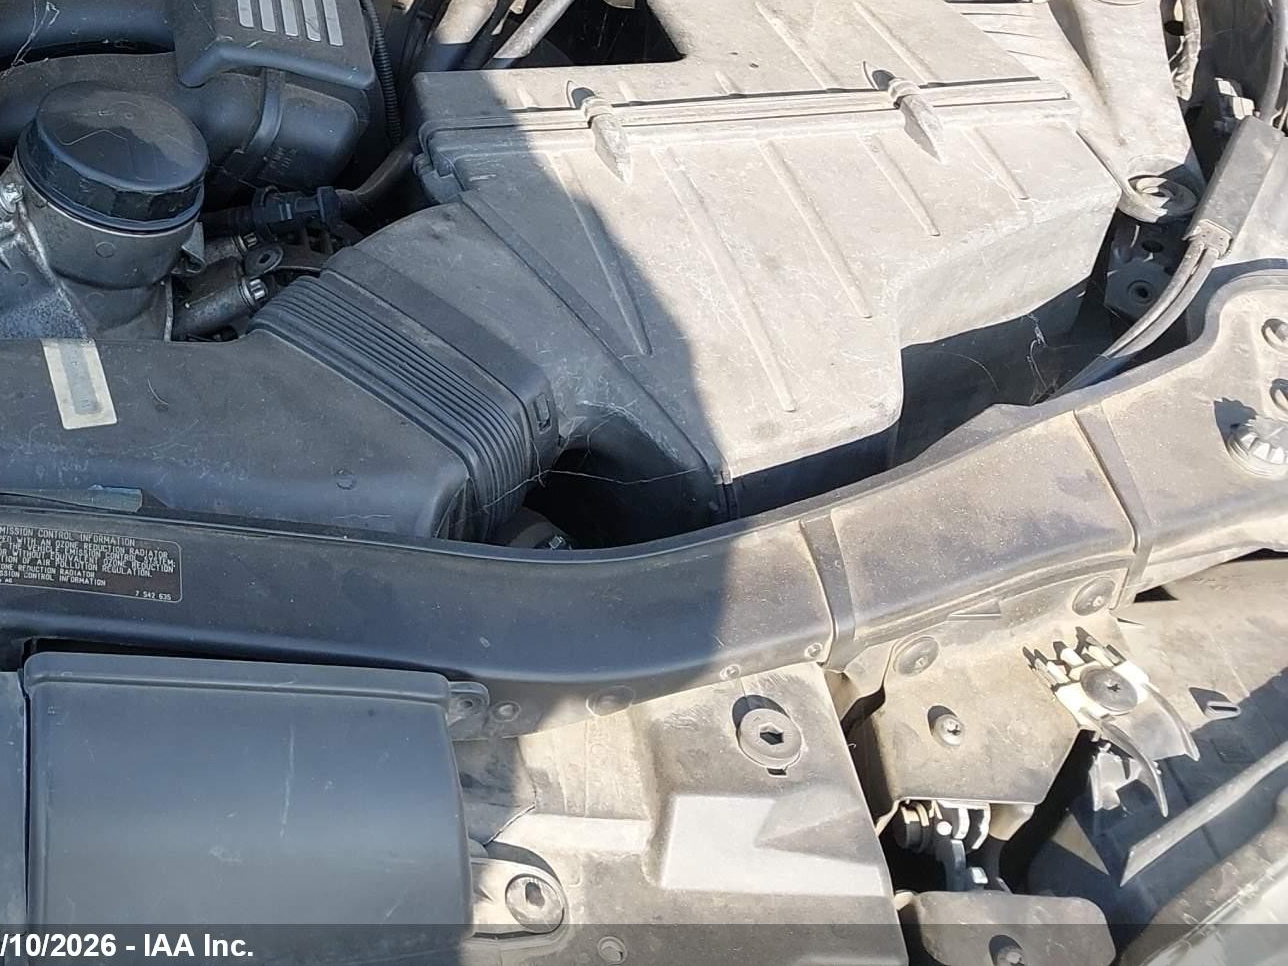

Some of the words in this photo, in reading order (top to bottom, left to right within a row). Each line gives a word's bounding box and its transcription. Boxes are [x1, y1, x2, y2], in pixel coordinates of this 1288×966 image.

[38, 529, 74, 540] CONTROL
[80, 533, 136, 547] INFORMATION
[16, 536, 36, 545] WITH
[40, 538, 51, 546] AN
[55, 540, 78, 549] OZONE
[84, 542, 125, 554] REDUCTION
[129, 547, 168, 559] RADIATOR
[27, 544, 60, 554] VEHICLE
[64, 548, 101, 558] EMISSION
[105, 552, 138, 562] CONTROL
[13, 548, 45, 559] WITHOUT
[103, 558, 127, 568] OZONE
[131, 561, 174, 573] REDUCTION
[22, 556, 30, 565] OF
[36, 558, 51, 566] AIR
[55, 559, 98, 571] POLLUTION
[18, 564, 57, 575] REDUCTION
[59, 568, 95, 579] RADIATOR
[23, 572, 55, 581] CONTROL
[59, 575, 106, 586] INFORMATION
